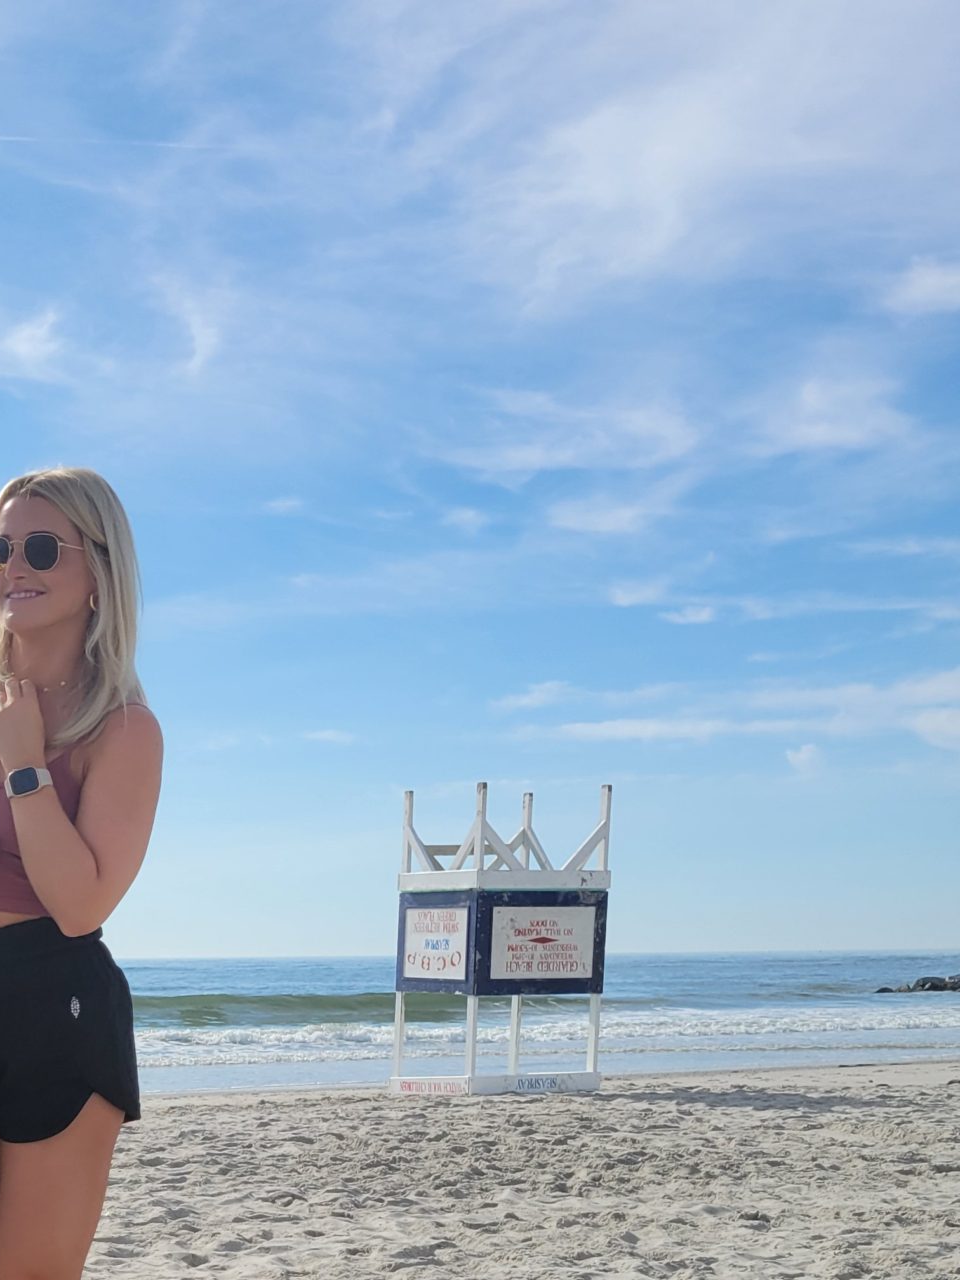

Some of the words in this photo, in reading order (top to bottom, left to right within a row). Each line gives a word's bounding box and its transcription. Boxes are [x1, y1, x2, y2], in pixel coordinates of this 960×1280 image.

[506, 961, 533, 973] BEACH
[537, 961, 578, 973] GUARDED
[516, 1077, 558, 1090] SEASPRAY
